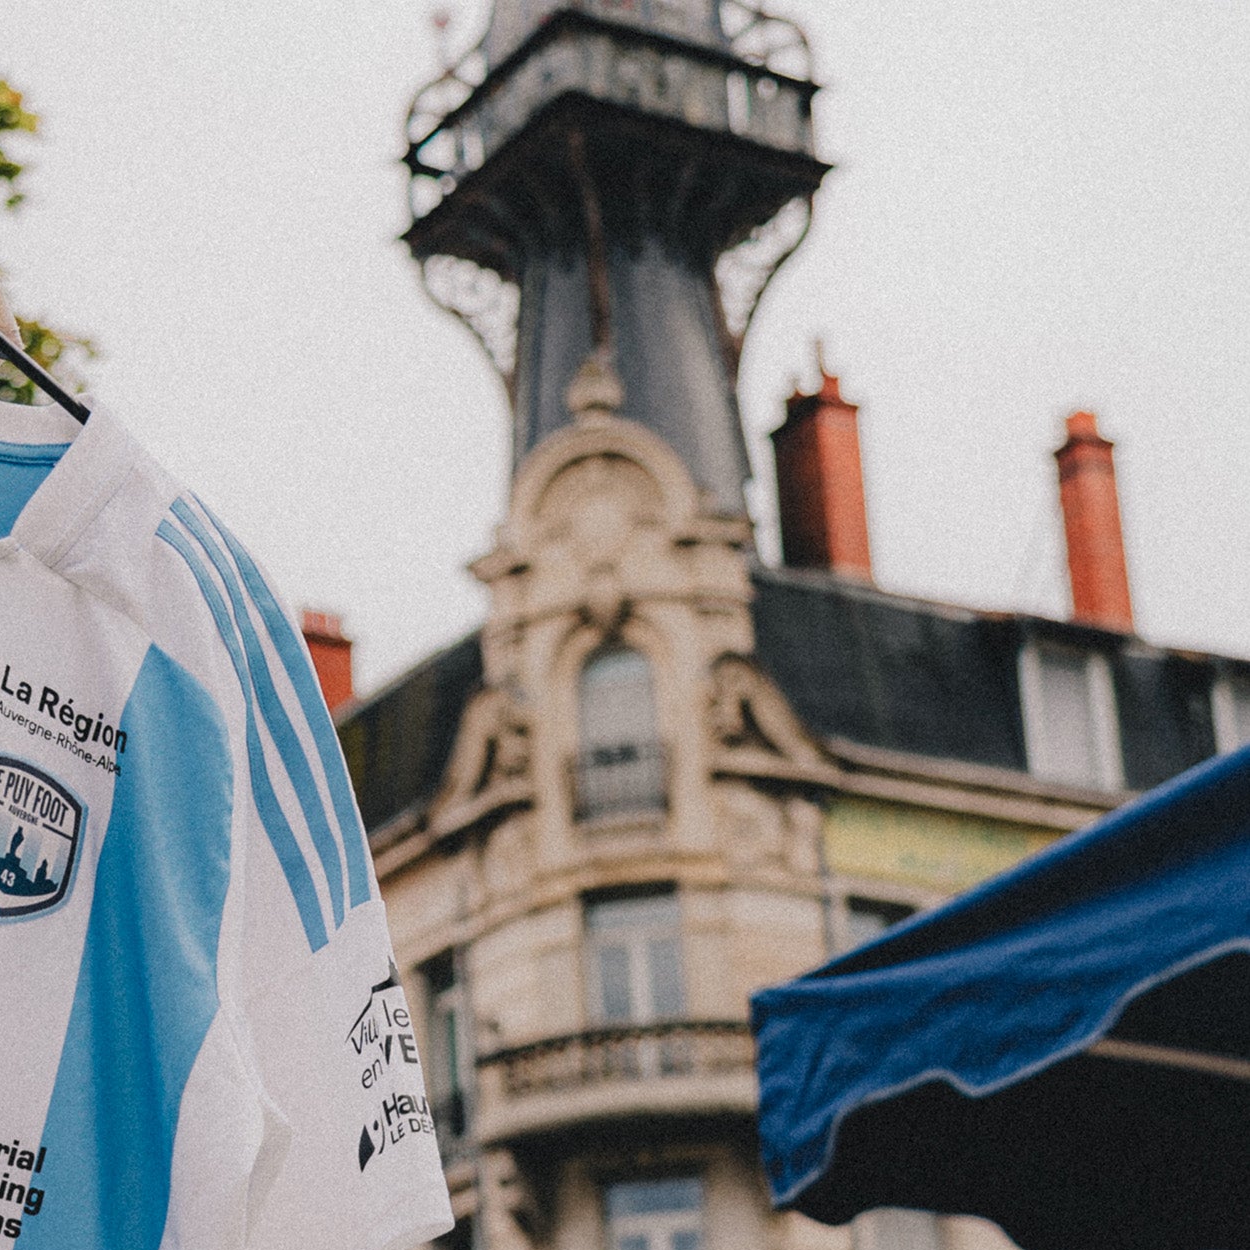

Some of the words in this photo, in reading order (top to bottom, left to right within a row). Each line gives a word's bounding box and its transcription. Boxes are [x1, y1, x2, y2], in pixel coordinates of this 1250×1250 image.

[0, 664, 33, 705] La
[38, 686, 128, 754] Région
[3, 771, 35, 808] PUY
[31, 784, 69, 828] FOOT
[0, 868, 17, 888] 43
[350, 1017, 379, 1055] Vill
[361, 1058, 384, 1089] en
[389, 1122, 406, 1145] LE
